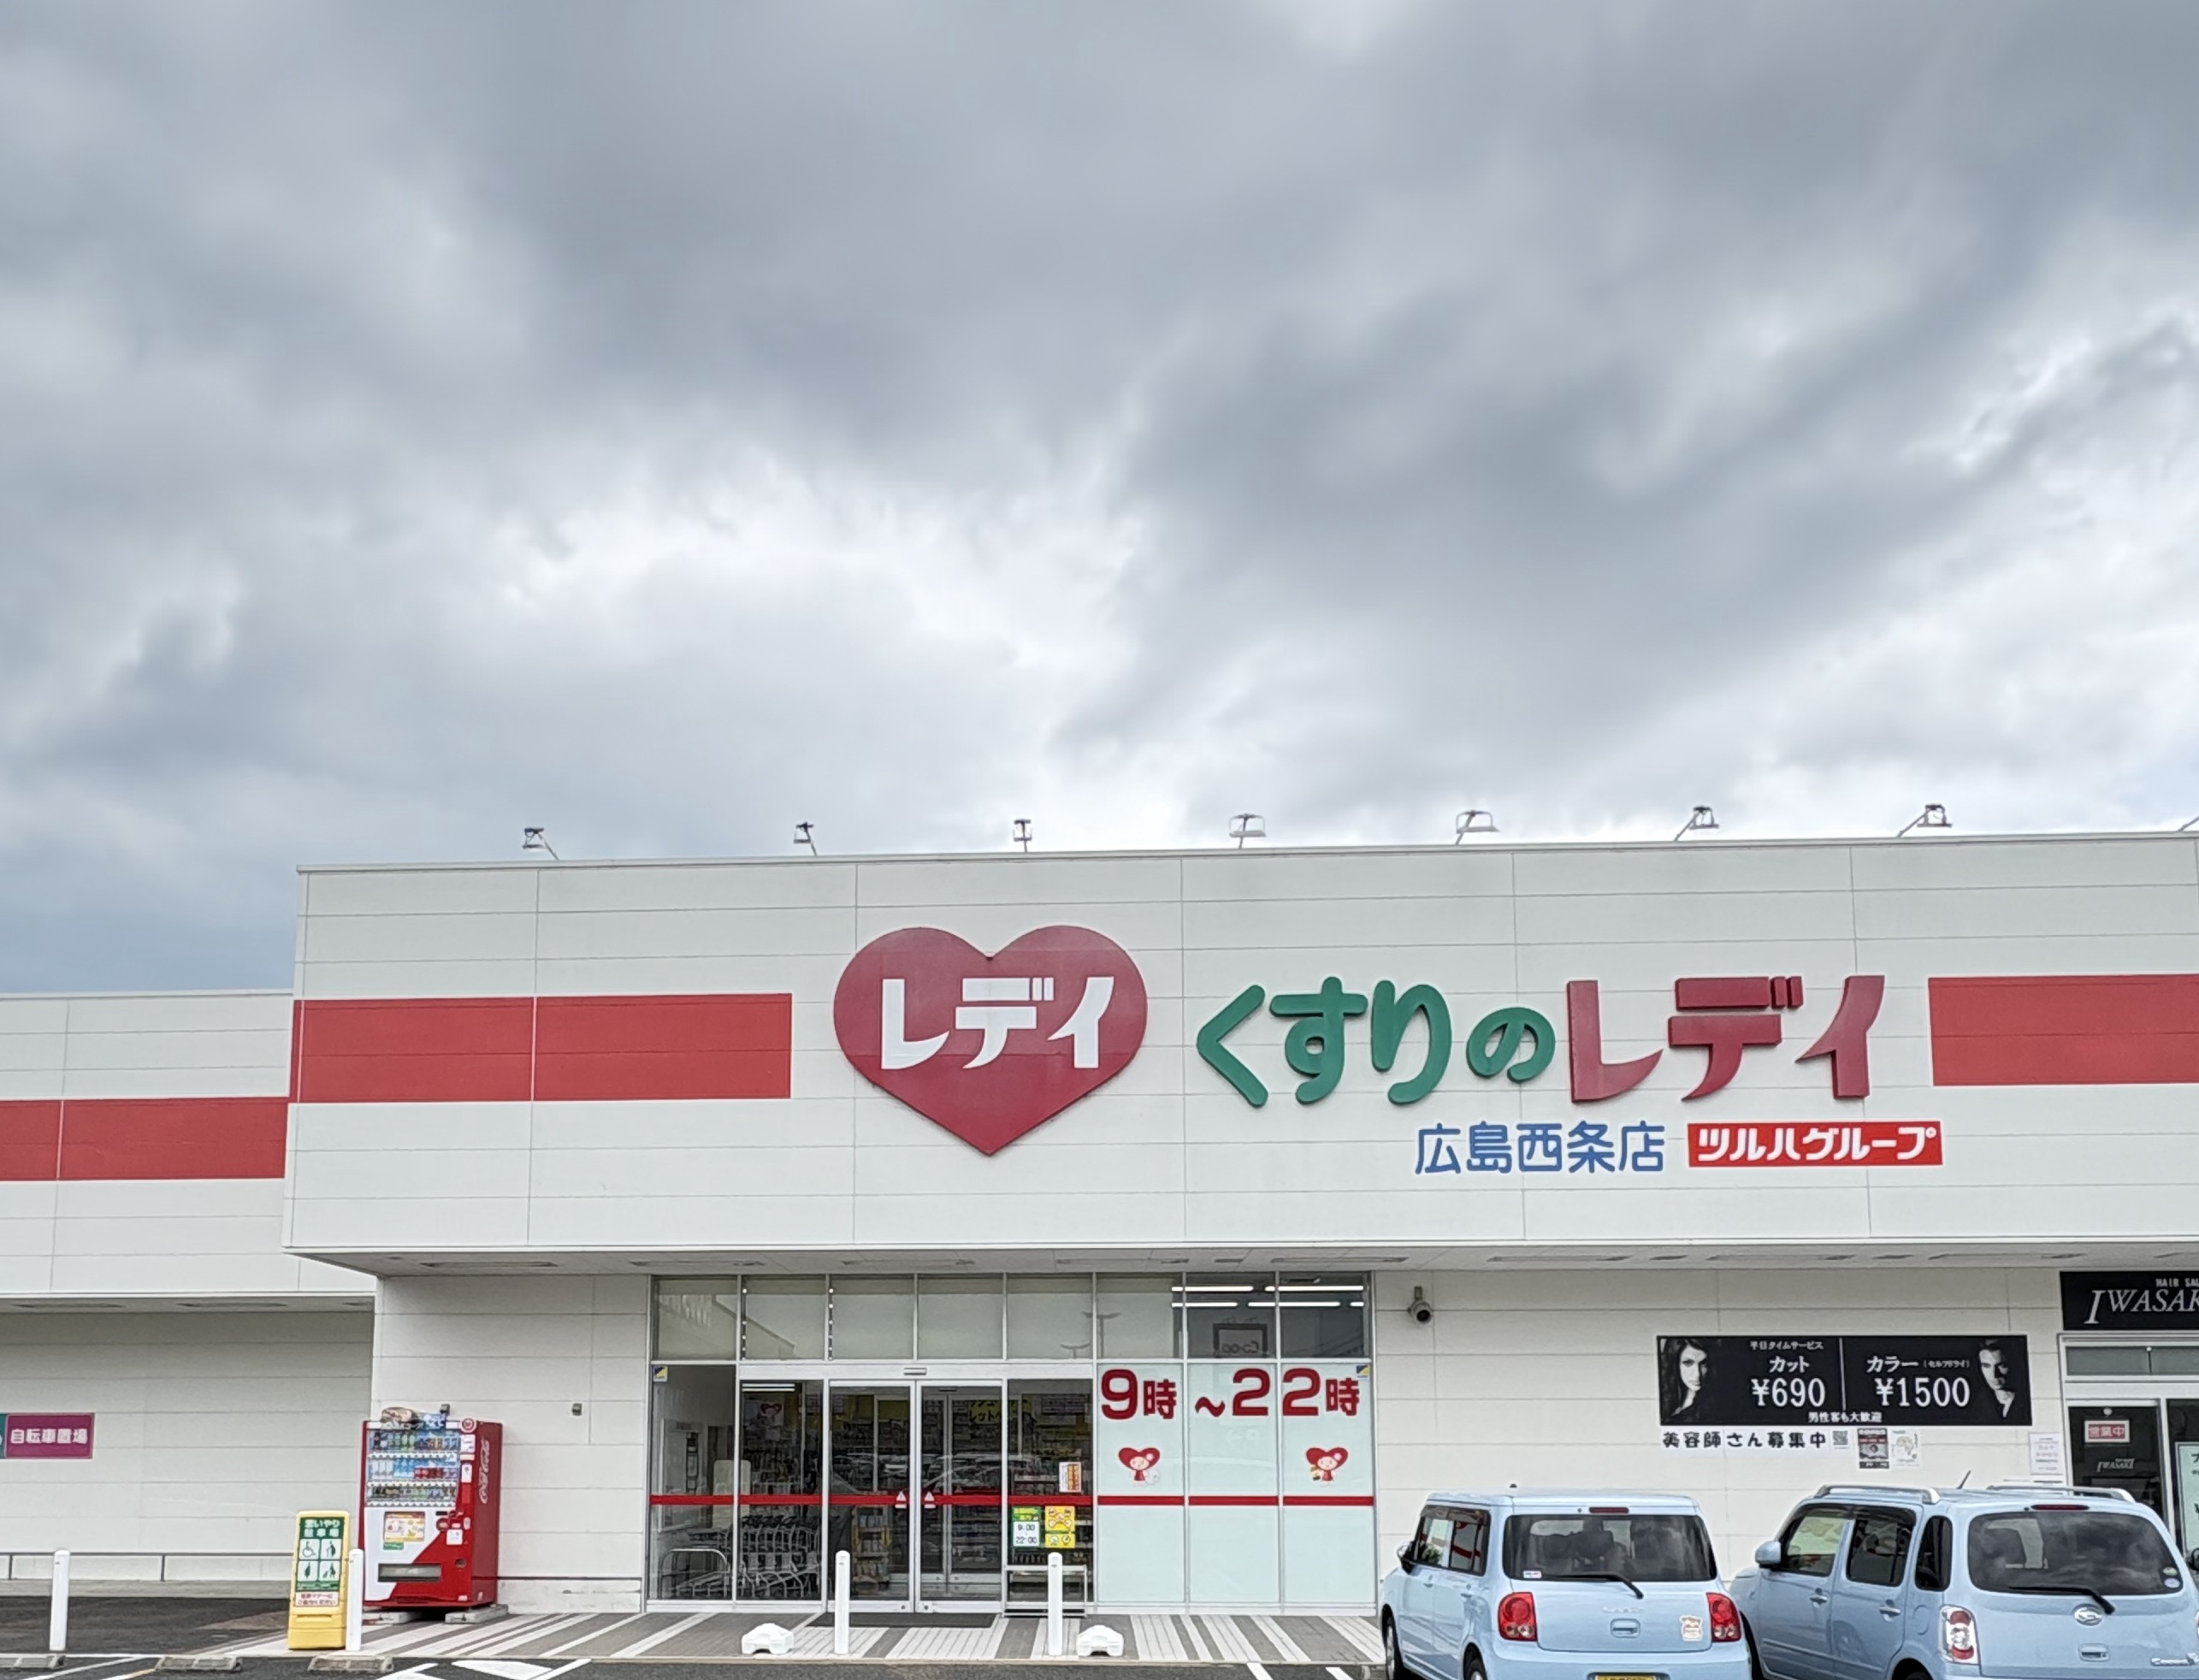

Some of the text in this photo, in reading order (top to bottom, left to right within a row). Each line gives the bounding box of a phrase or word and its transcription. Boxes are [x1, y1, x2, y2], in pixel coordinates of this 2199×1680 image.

[881, 977, 1114, 1069] レディ
[1416, 1121, 1665, 1174] 広島西条店
[1698, 1127, 1936, 1162] ツルハグループ
[2155, 1278, 2179, 1287] HAIR
[1769, 1356, 1810, 1373] カット
[1866, 1356, 1919, 1373] カラー
[1751, 1378, 1825, 1407] ¥690
[1874, 1377, 1970, 1407] ¥1500
[1662, 1431, 1826, 1448] 美容師さん募集中
